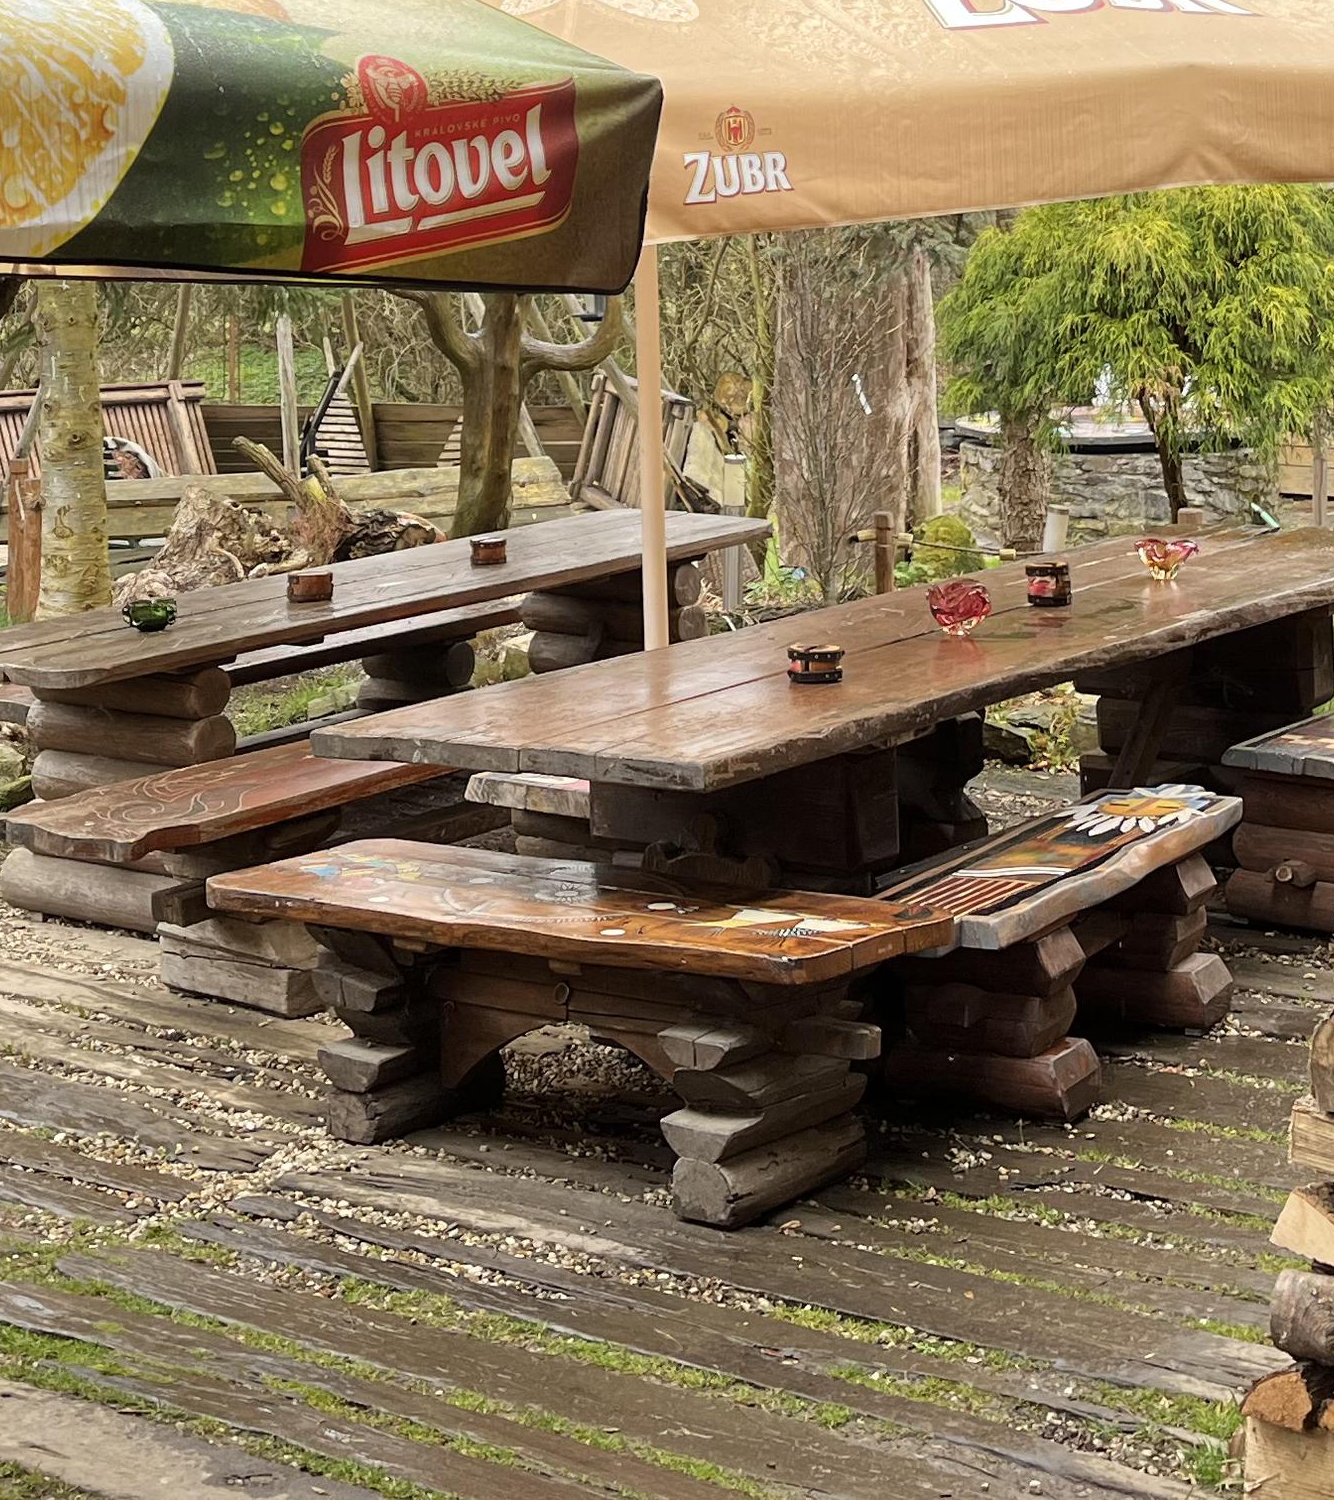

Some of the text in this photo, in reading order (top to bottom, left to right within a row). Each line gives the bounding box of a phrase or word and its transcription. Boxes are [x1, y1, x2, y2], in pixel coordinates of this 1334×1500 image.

[492, 112, 521, 126] PIVO
[341, 102, 553, 246] Litovel
[682, 150, 795, 205] ZUBR
